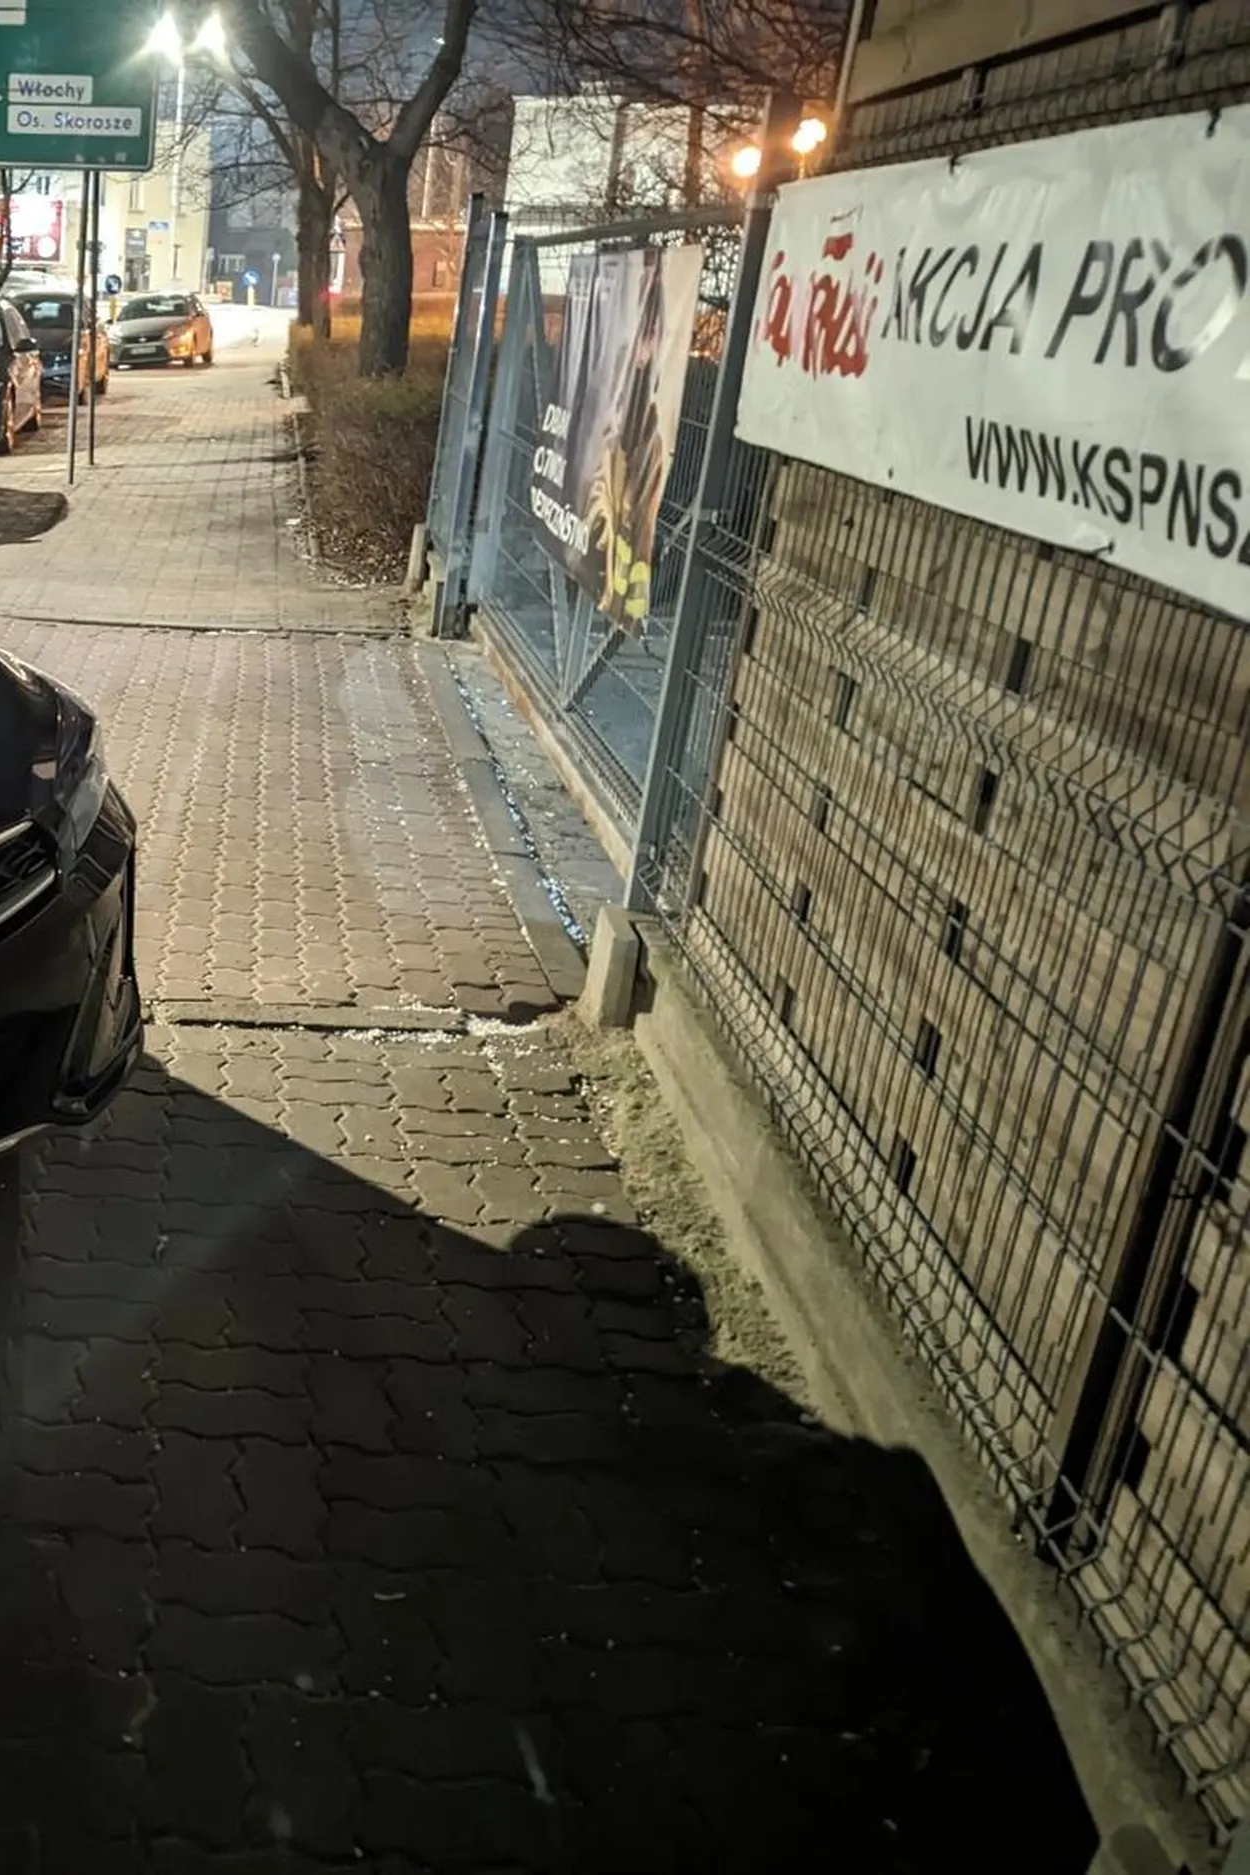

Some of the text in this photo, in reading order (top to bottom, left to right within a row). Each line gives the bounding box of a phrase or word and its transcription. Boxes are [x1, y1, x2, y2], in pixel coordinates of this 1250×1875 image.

[17, 79, 85, 101] Włochy
[16, 110, 134, 132] Os. Skorosze
[882, 241, 1044, 355] AKCJA
